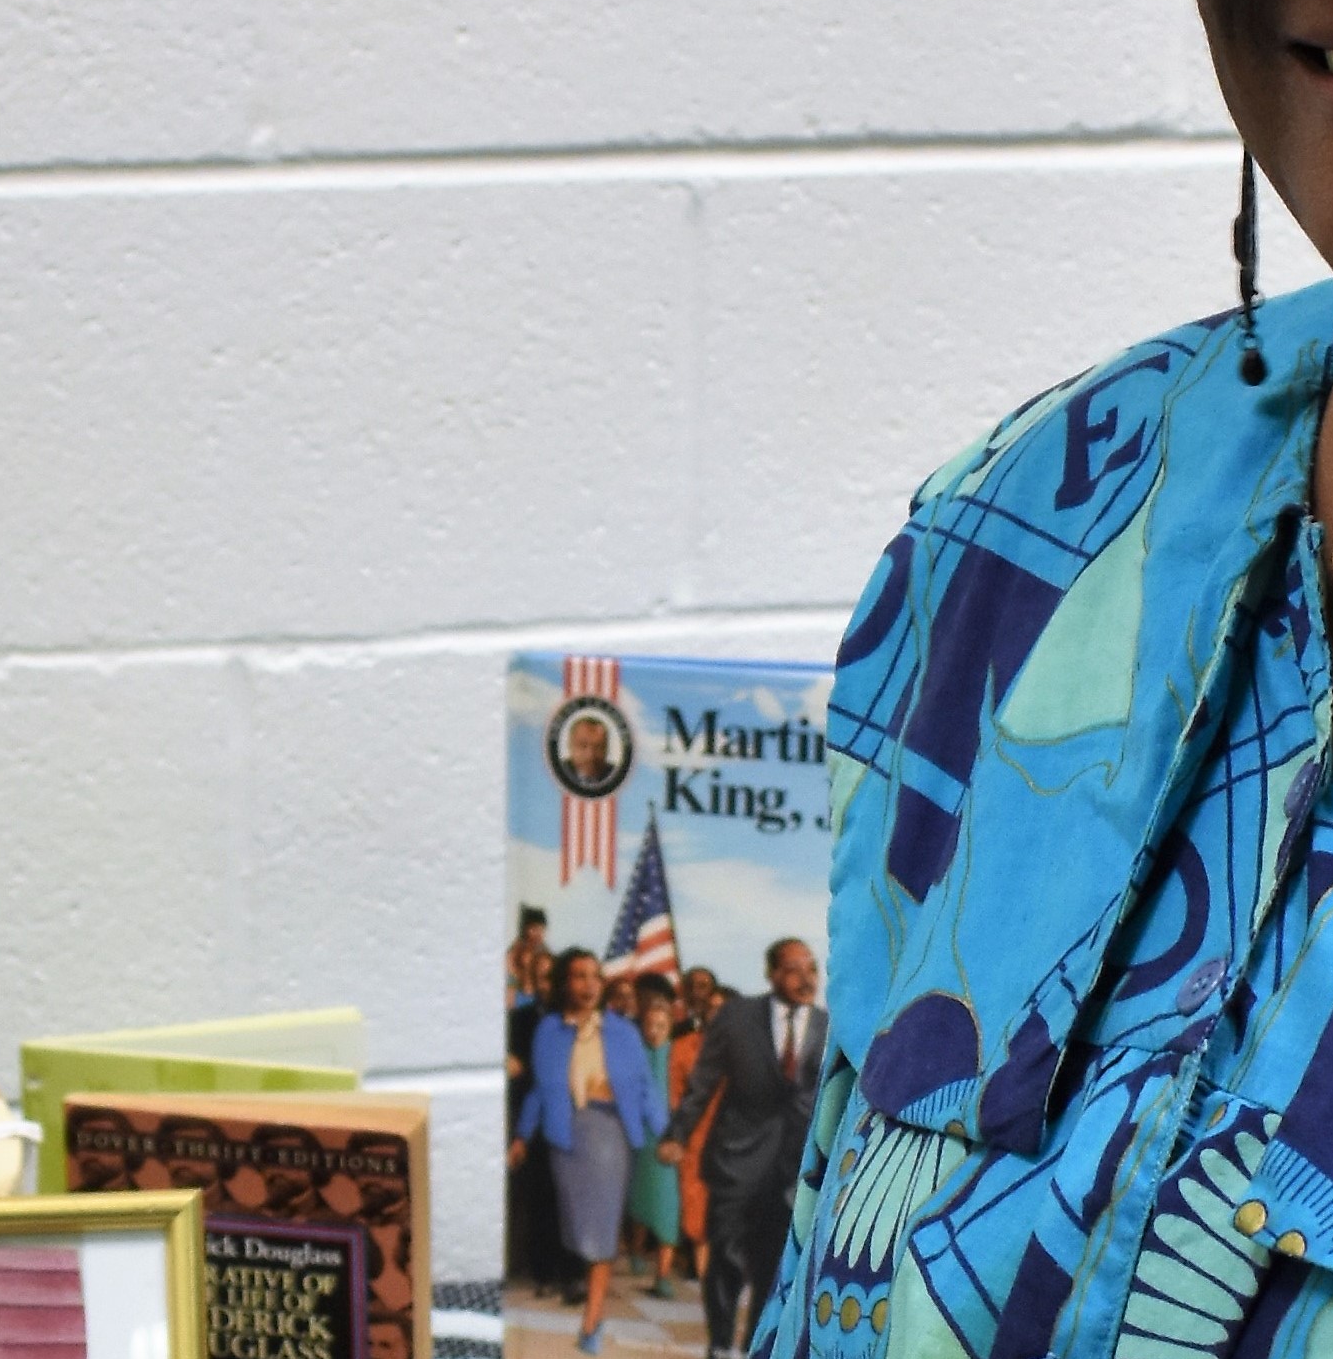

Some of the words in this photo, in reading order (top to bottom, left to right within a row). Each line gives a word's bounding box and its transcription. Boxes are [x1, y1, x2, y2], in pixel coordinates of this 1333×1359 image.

[663, 767, 803, 833] King,
[75, 1131, 156, 1153] DOVER
[173, 1139, 262, 1163] THRIFT
[277, 1147, 398, 1174] EDITIONS
[244, 1237, 342, 1269] Douglass
[226, 1287, 280, 1310] LIFE
[283, 1293, 319, 1314] OF
[303, 1273, 338, 1296] OF
